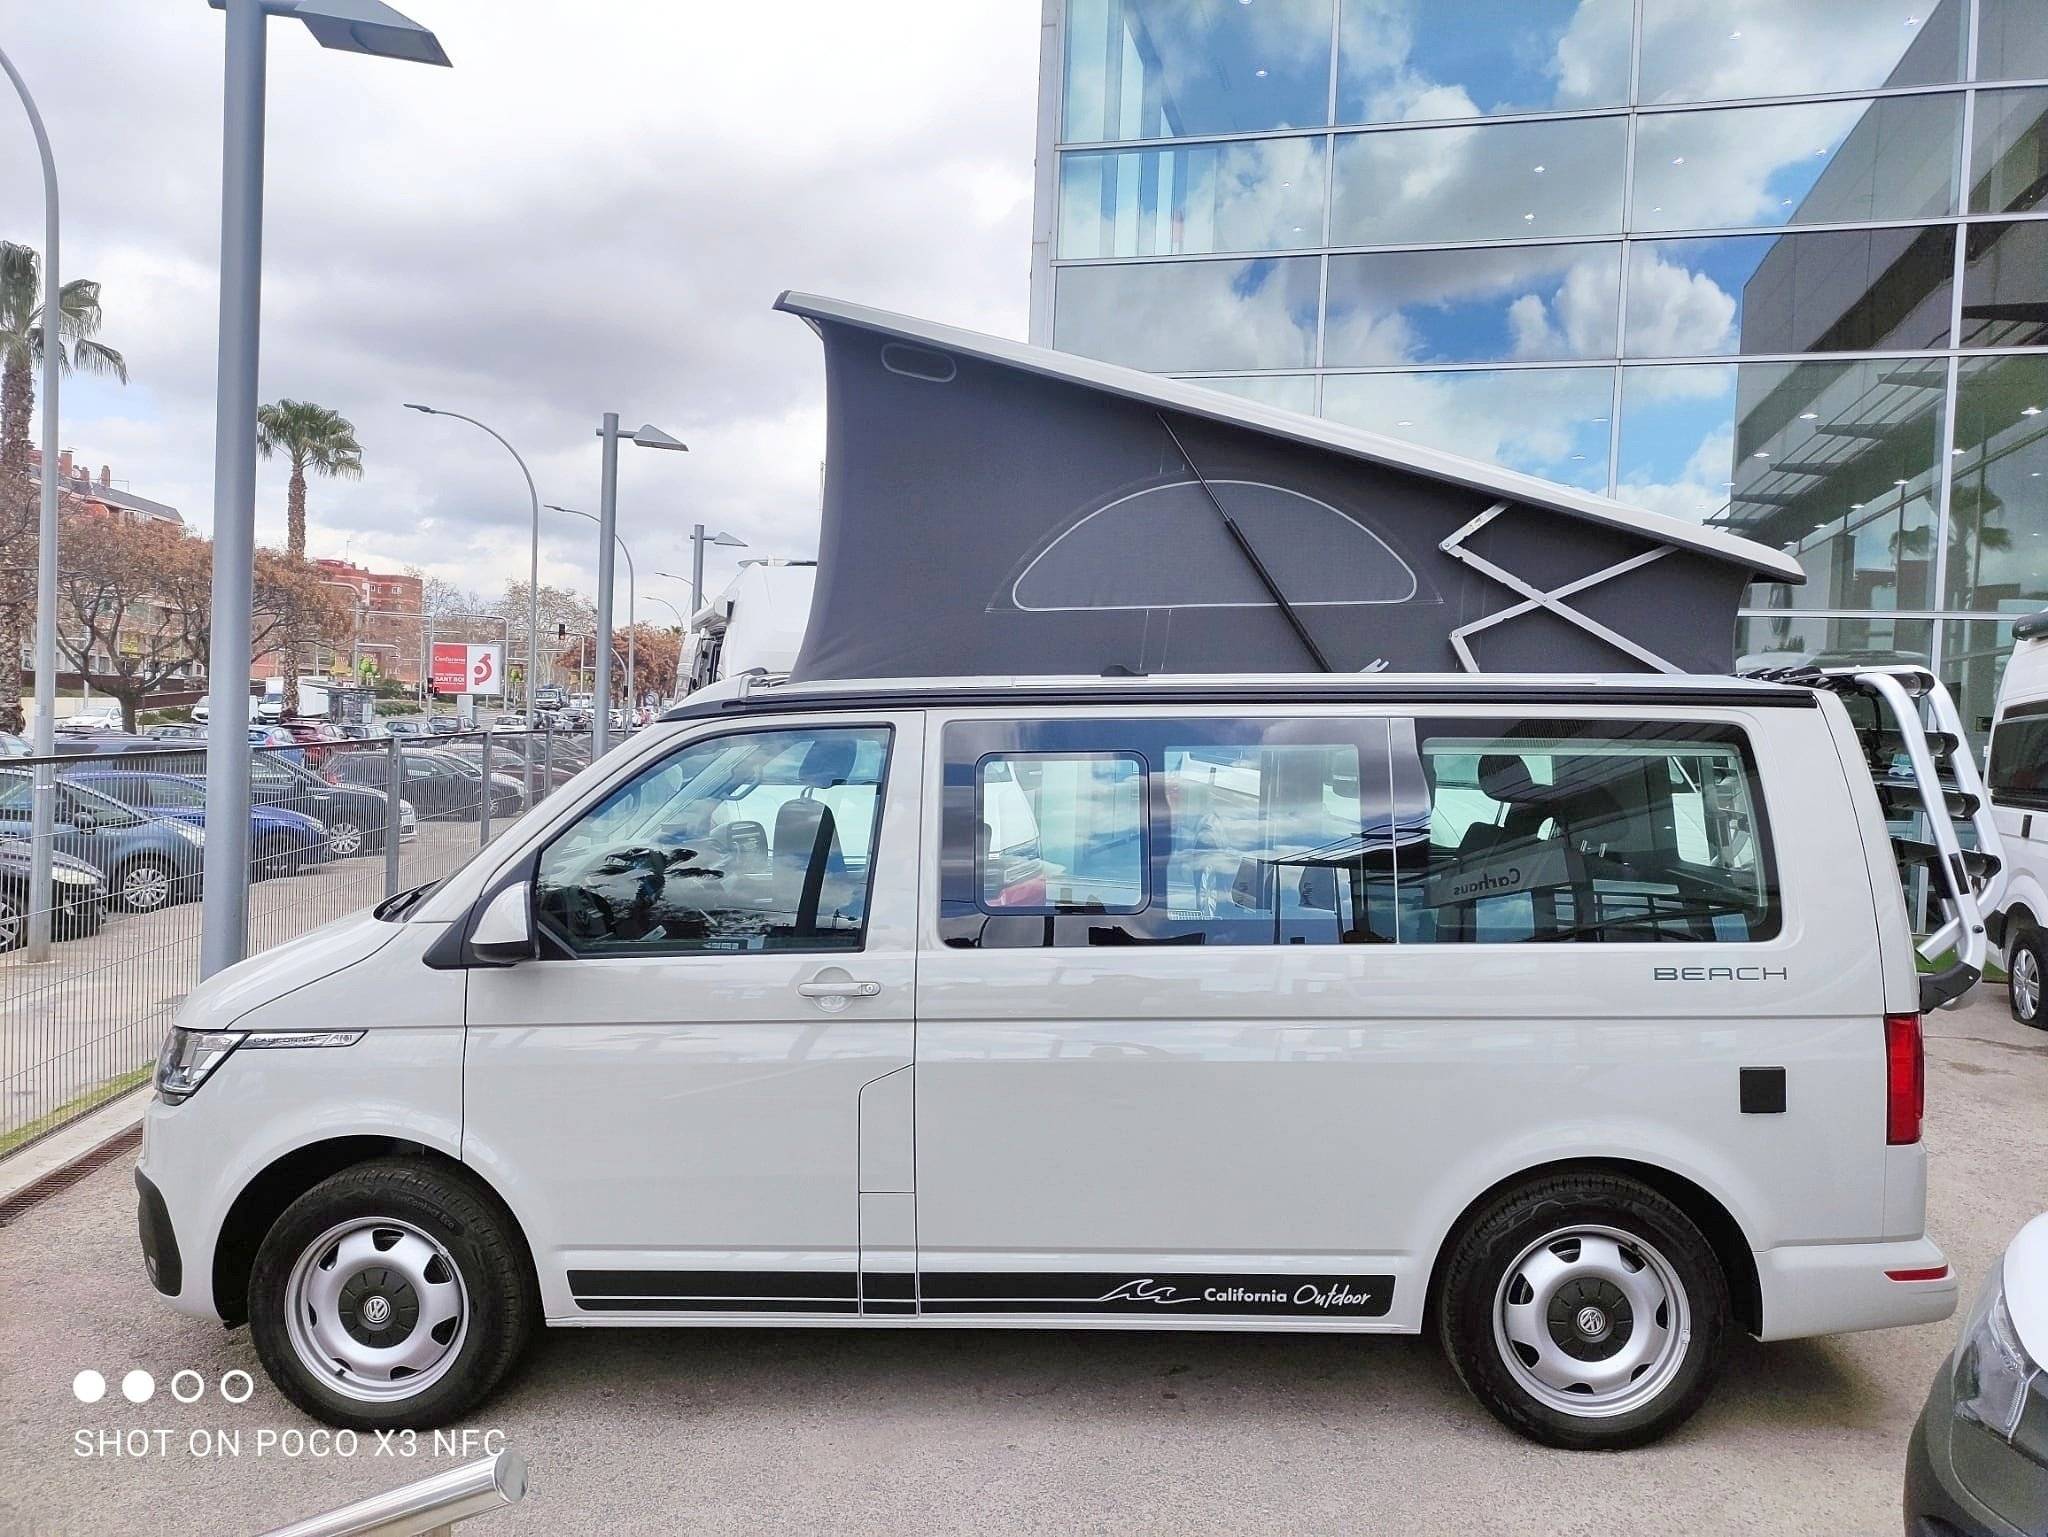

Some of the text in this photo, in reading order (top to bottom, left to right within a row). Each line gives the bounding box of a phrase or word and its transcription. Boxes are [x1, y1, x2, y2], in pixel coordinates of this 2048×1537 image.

[1653, 966, 1788, 981] BEACH
[1204, 1283, 1372, 1309] California Outdoor
